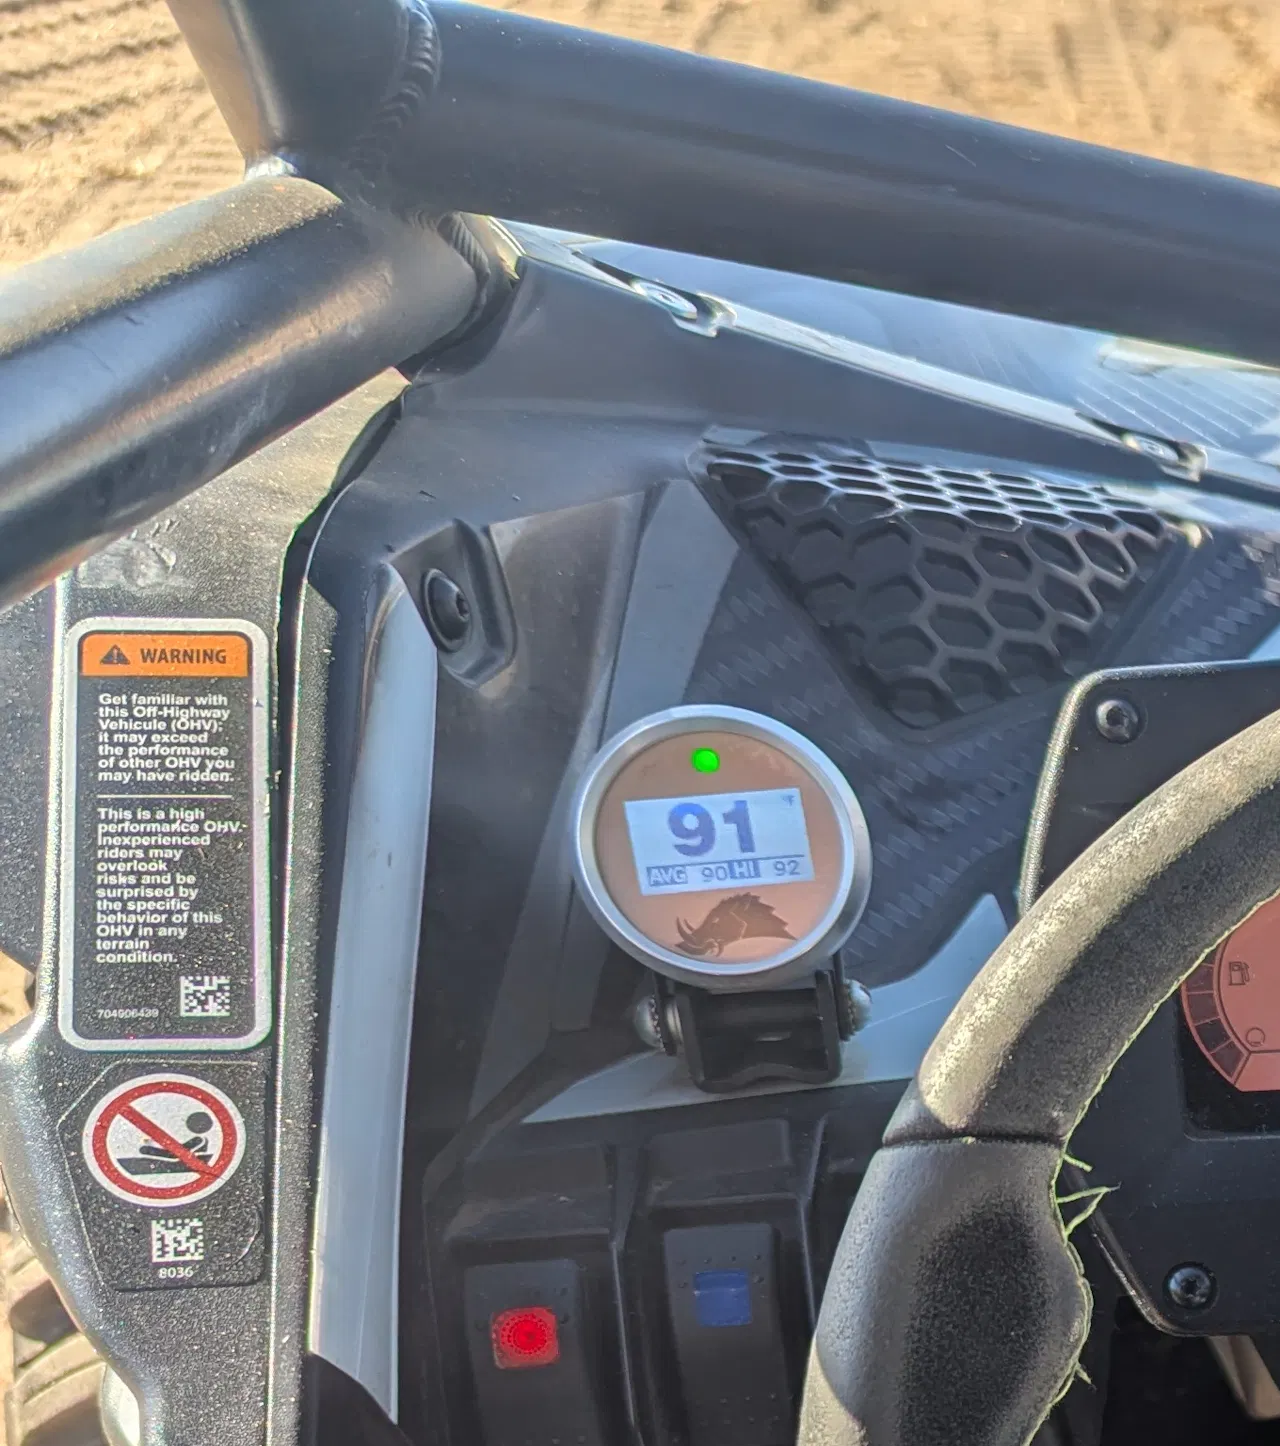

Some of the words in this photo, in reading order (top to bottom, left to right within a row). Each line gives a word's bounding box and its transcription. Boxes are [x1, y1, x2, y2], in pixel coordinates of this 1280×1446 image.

[140, 648, 227, 665] WARNING
[98, 693, 128, 706] Get
[131, 693, 191, 706] familiar
[194, 693, 228, 706] with
[98, 706, 129, 718] this
[133, 706, 231, 721] Off-Highway
[99, 718, 167, 731] Vehicule
[98, 732, 109, 743] it
[113, 733, 147, 745] may
[151, 731, 209, 743] exceed
[98, 744, 124, 756] the
[128, 744, 230, 758] performance
[97, 757, 116, 769] of
[118, 757, 161, 769] other
[165, 757, 202, 769] OHV
[204, 759, 236, 771] you
[97, 771, 132, 784] may
[136, 770, 175, 782] have
[178, 769, 236, 782] ridden.
[96, 807, 133, 820] This
[136, 807, 152, 820] is
[155, 810, 166, 820] a
[169, 807, 205, 822] high
[97, 820, 200, 834] performance
[667, 799, 757, 857] 91
[97, 832, 211, 847] Inexperienced
[97, 847, 145, 859] riders
[149, 848, 184, 861] may
[96, 860, 169, 872] overlook
[649, 865, 688, 884] AVG
[701, 864, 728, 883] 90
[731, 860, 760, 880] HI
[772, 859, 801, 877] 92
[96, 873, 137, 885] risks
[141, 873, 172, 885] and
[175, 873, 197, 885] be
[95, 886, 175, 900] surprised
[178, 886, 200, 900] by
[96, 899, 122, 911] the
[126, 899, 191, 912] specific
[96, 912, 168, 924] behavior
[171, 912, 189, 923] of
[192, 912, 223, 924] this
[96, 925, 134, 937] OHV
[138, 925, 154, 937] in
[158, 926, 188, 939] any
[95, 937, 150, 950] terrain
[95, 951, 178, 964] condition.
[158, 1265, 195, 1279] 8036
